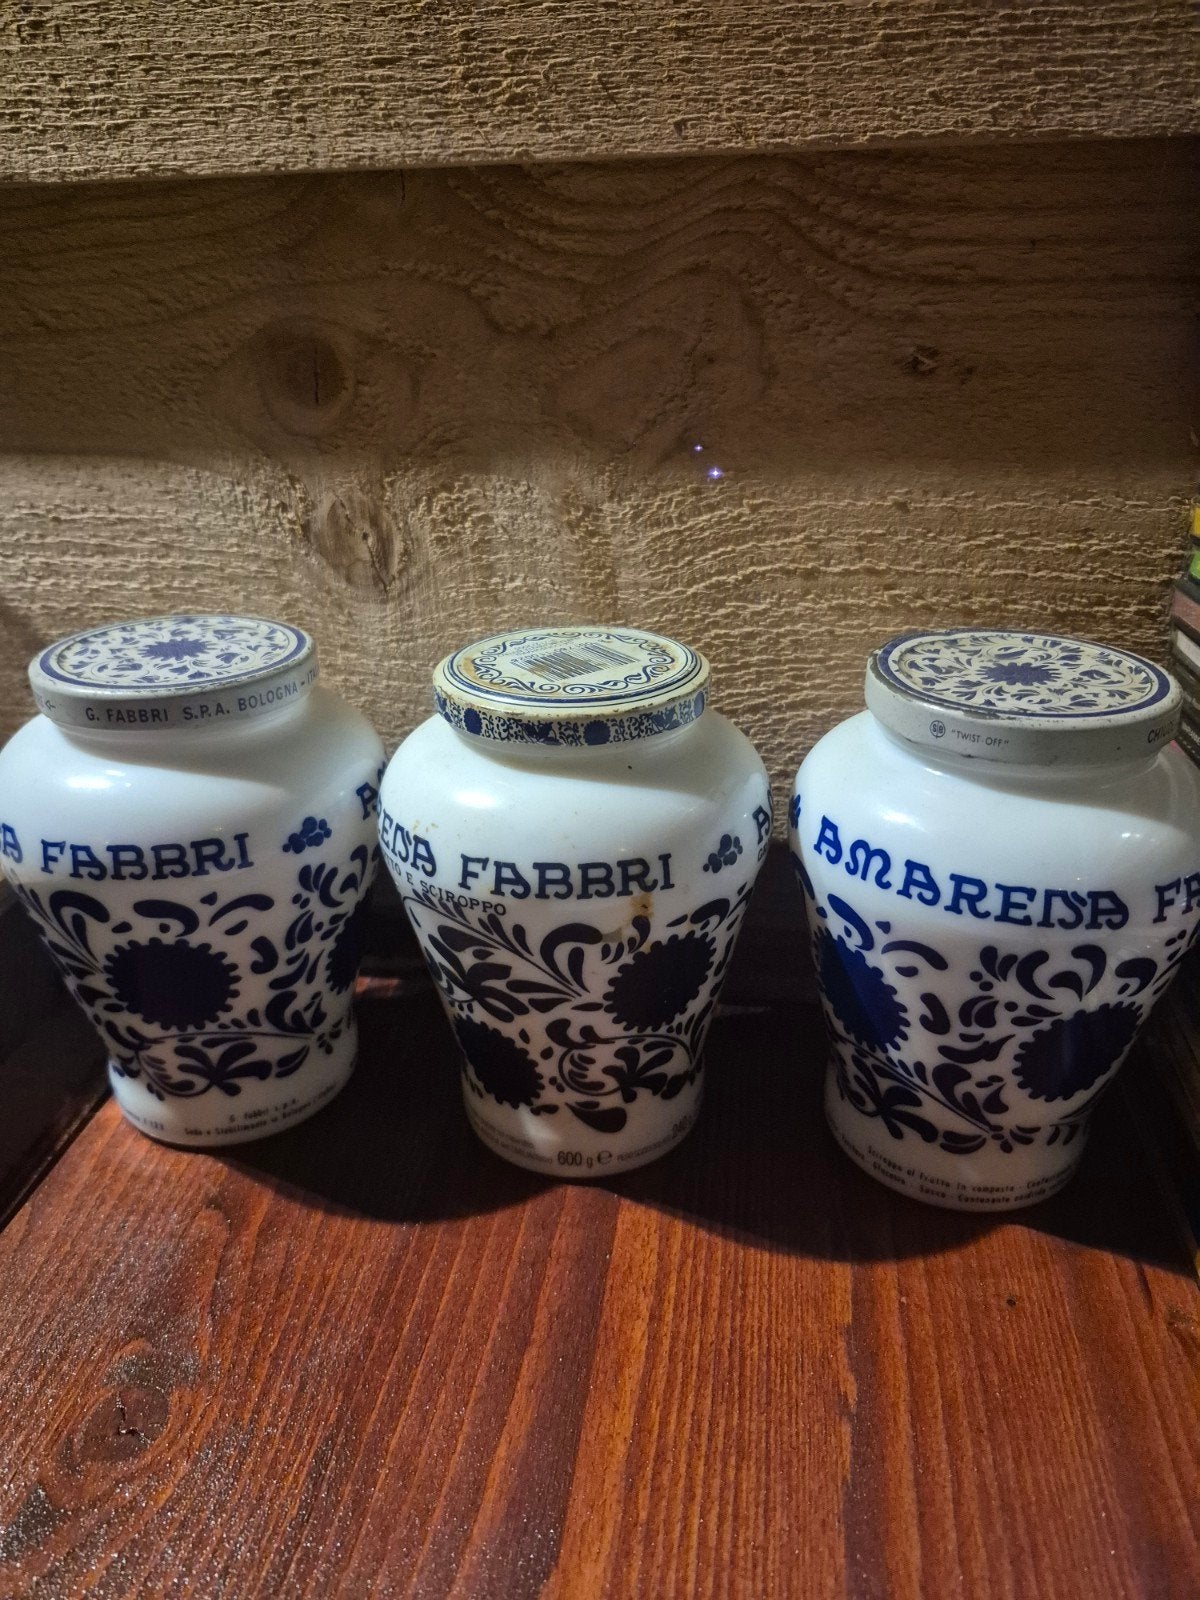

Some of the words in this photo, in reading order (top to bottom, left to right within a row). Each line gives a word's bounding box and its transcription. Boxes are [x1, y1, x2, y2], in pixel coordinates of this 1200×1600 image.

[86, 707, 100, 722] G.
[107, 707, 169, 724] FABBRI
[183, 702, 230, 721] S.P.A.
[238, 681, 299, 713] BOLOGNA
[0, 822, 24, 864] A
[41, 832, 254, 881] FABBRI
[406, 872, 415, 886] E
[420, 880, 507, 916] SCIROPPO
[458, 853, 675, 901] FABBRI
[813, 815, 1130, 931] AMARENA
[557, 1150, 583, 1166] 600
[586, 1156, 594, 1169] g
